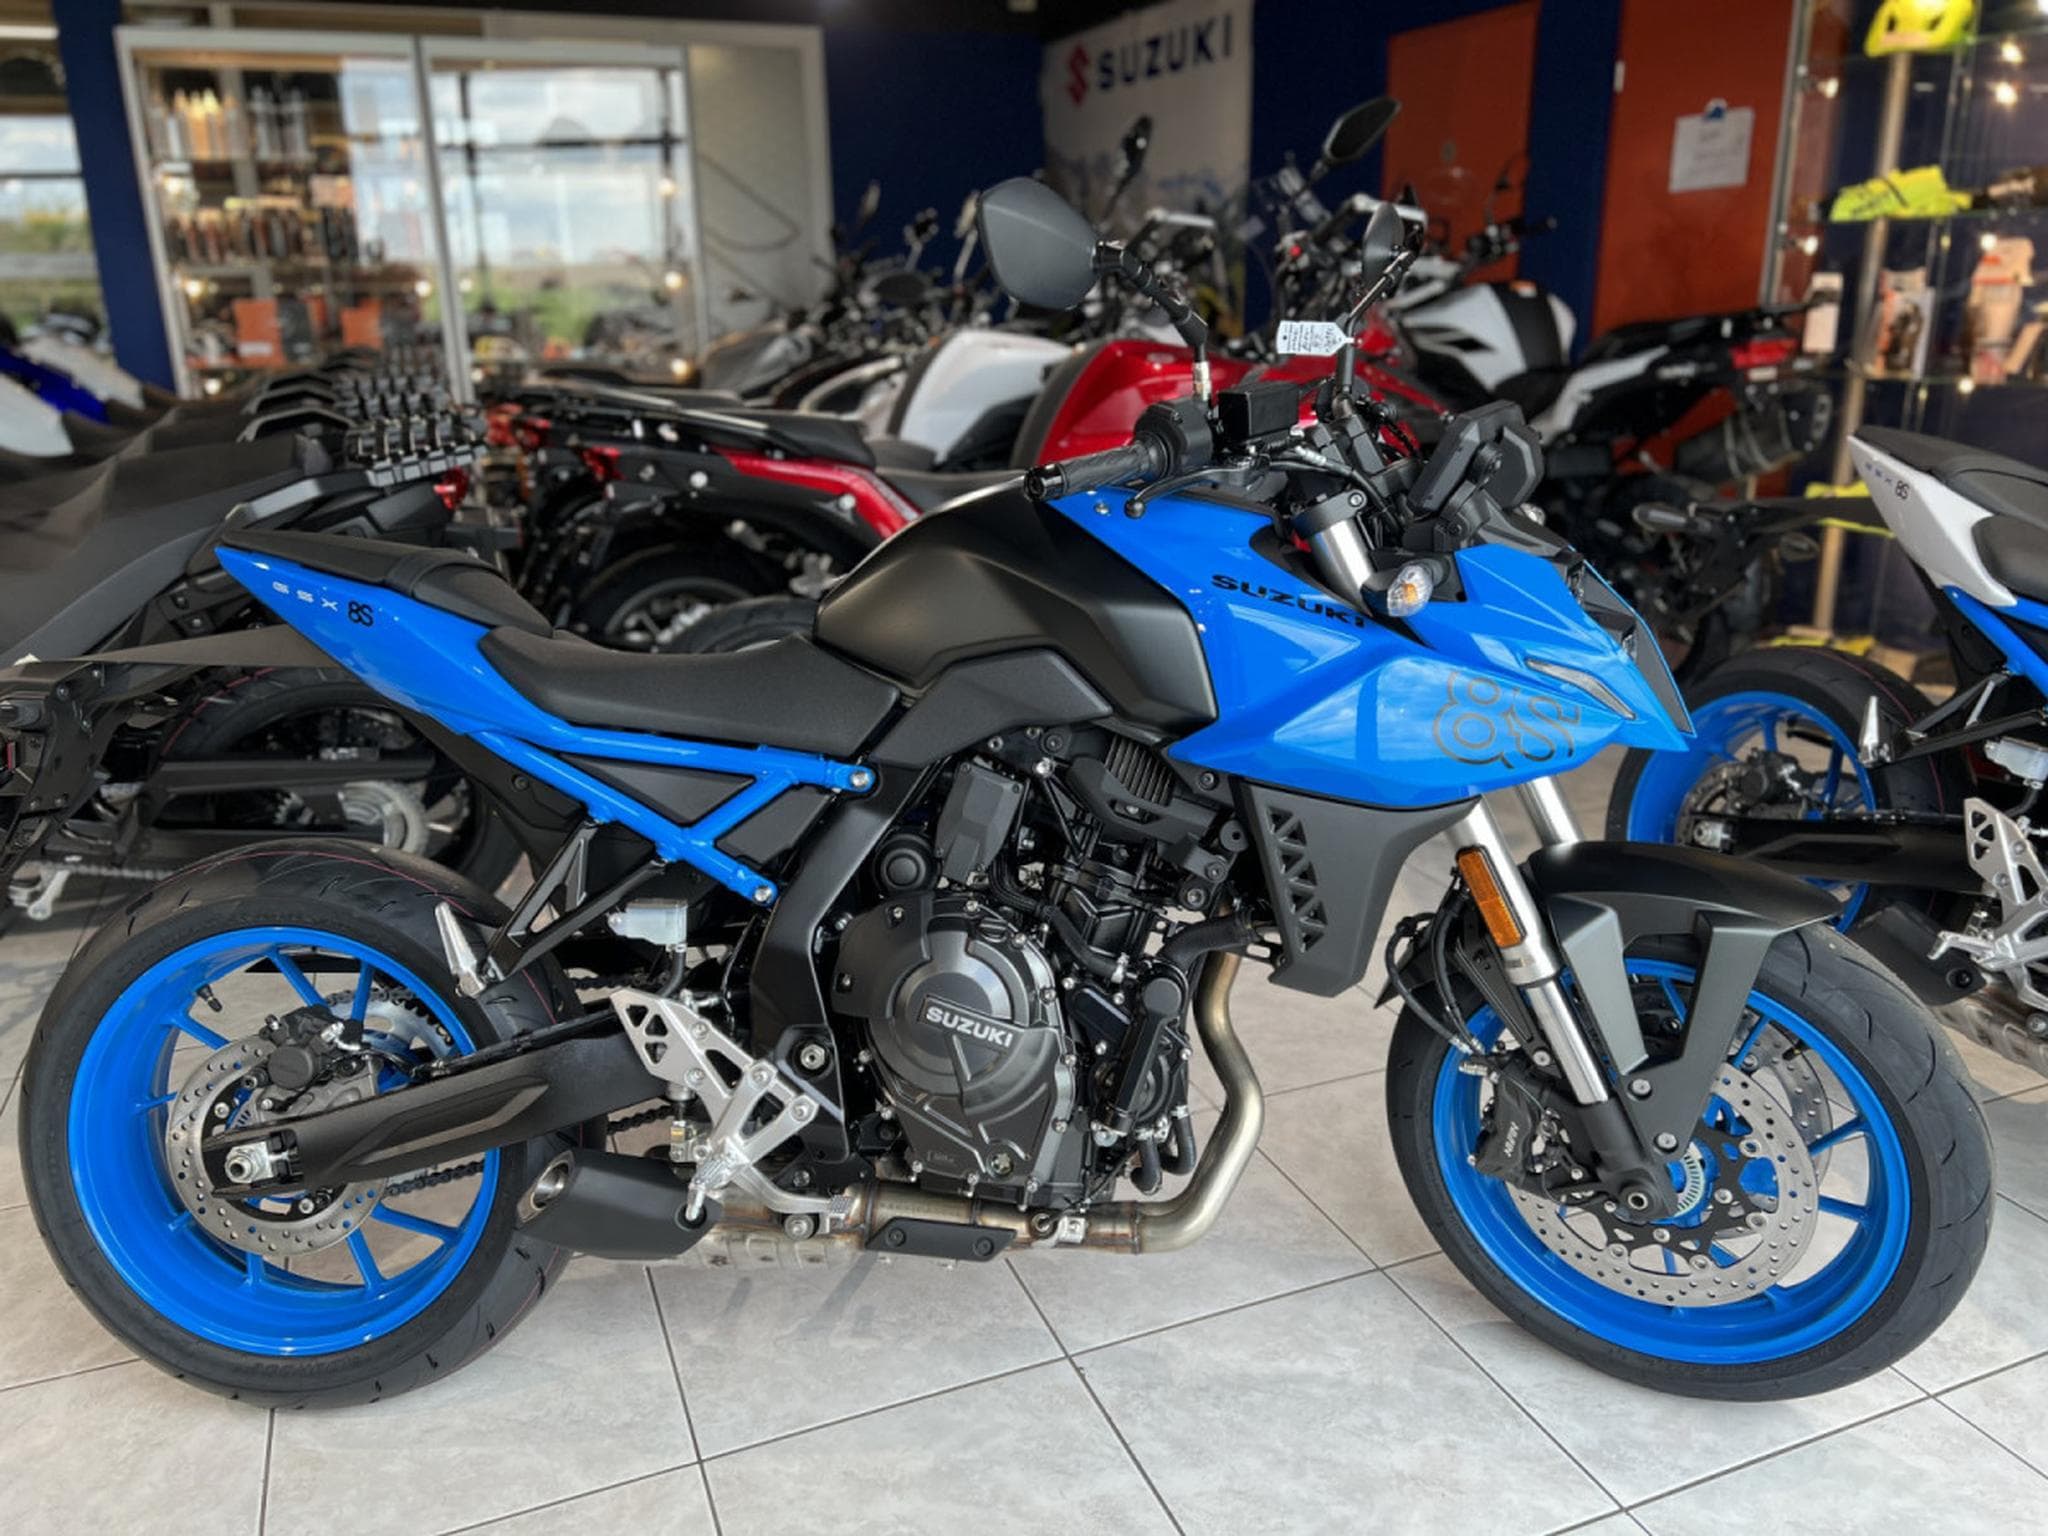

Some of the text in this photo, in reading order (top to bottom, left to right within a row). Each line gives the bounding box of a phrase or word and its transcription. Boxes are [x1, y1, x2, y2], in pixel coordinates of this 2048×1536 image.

[1099, 14, 1233, 90] SUZUKI
[348, 600, 374, 627] 8S
[1211, 574, 1365, 628] SUZUKI
[926, 1006, 1013, 1048] SUZUKI
